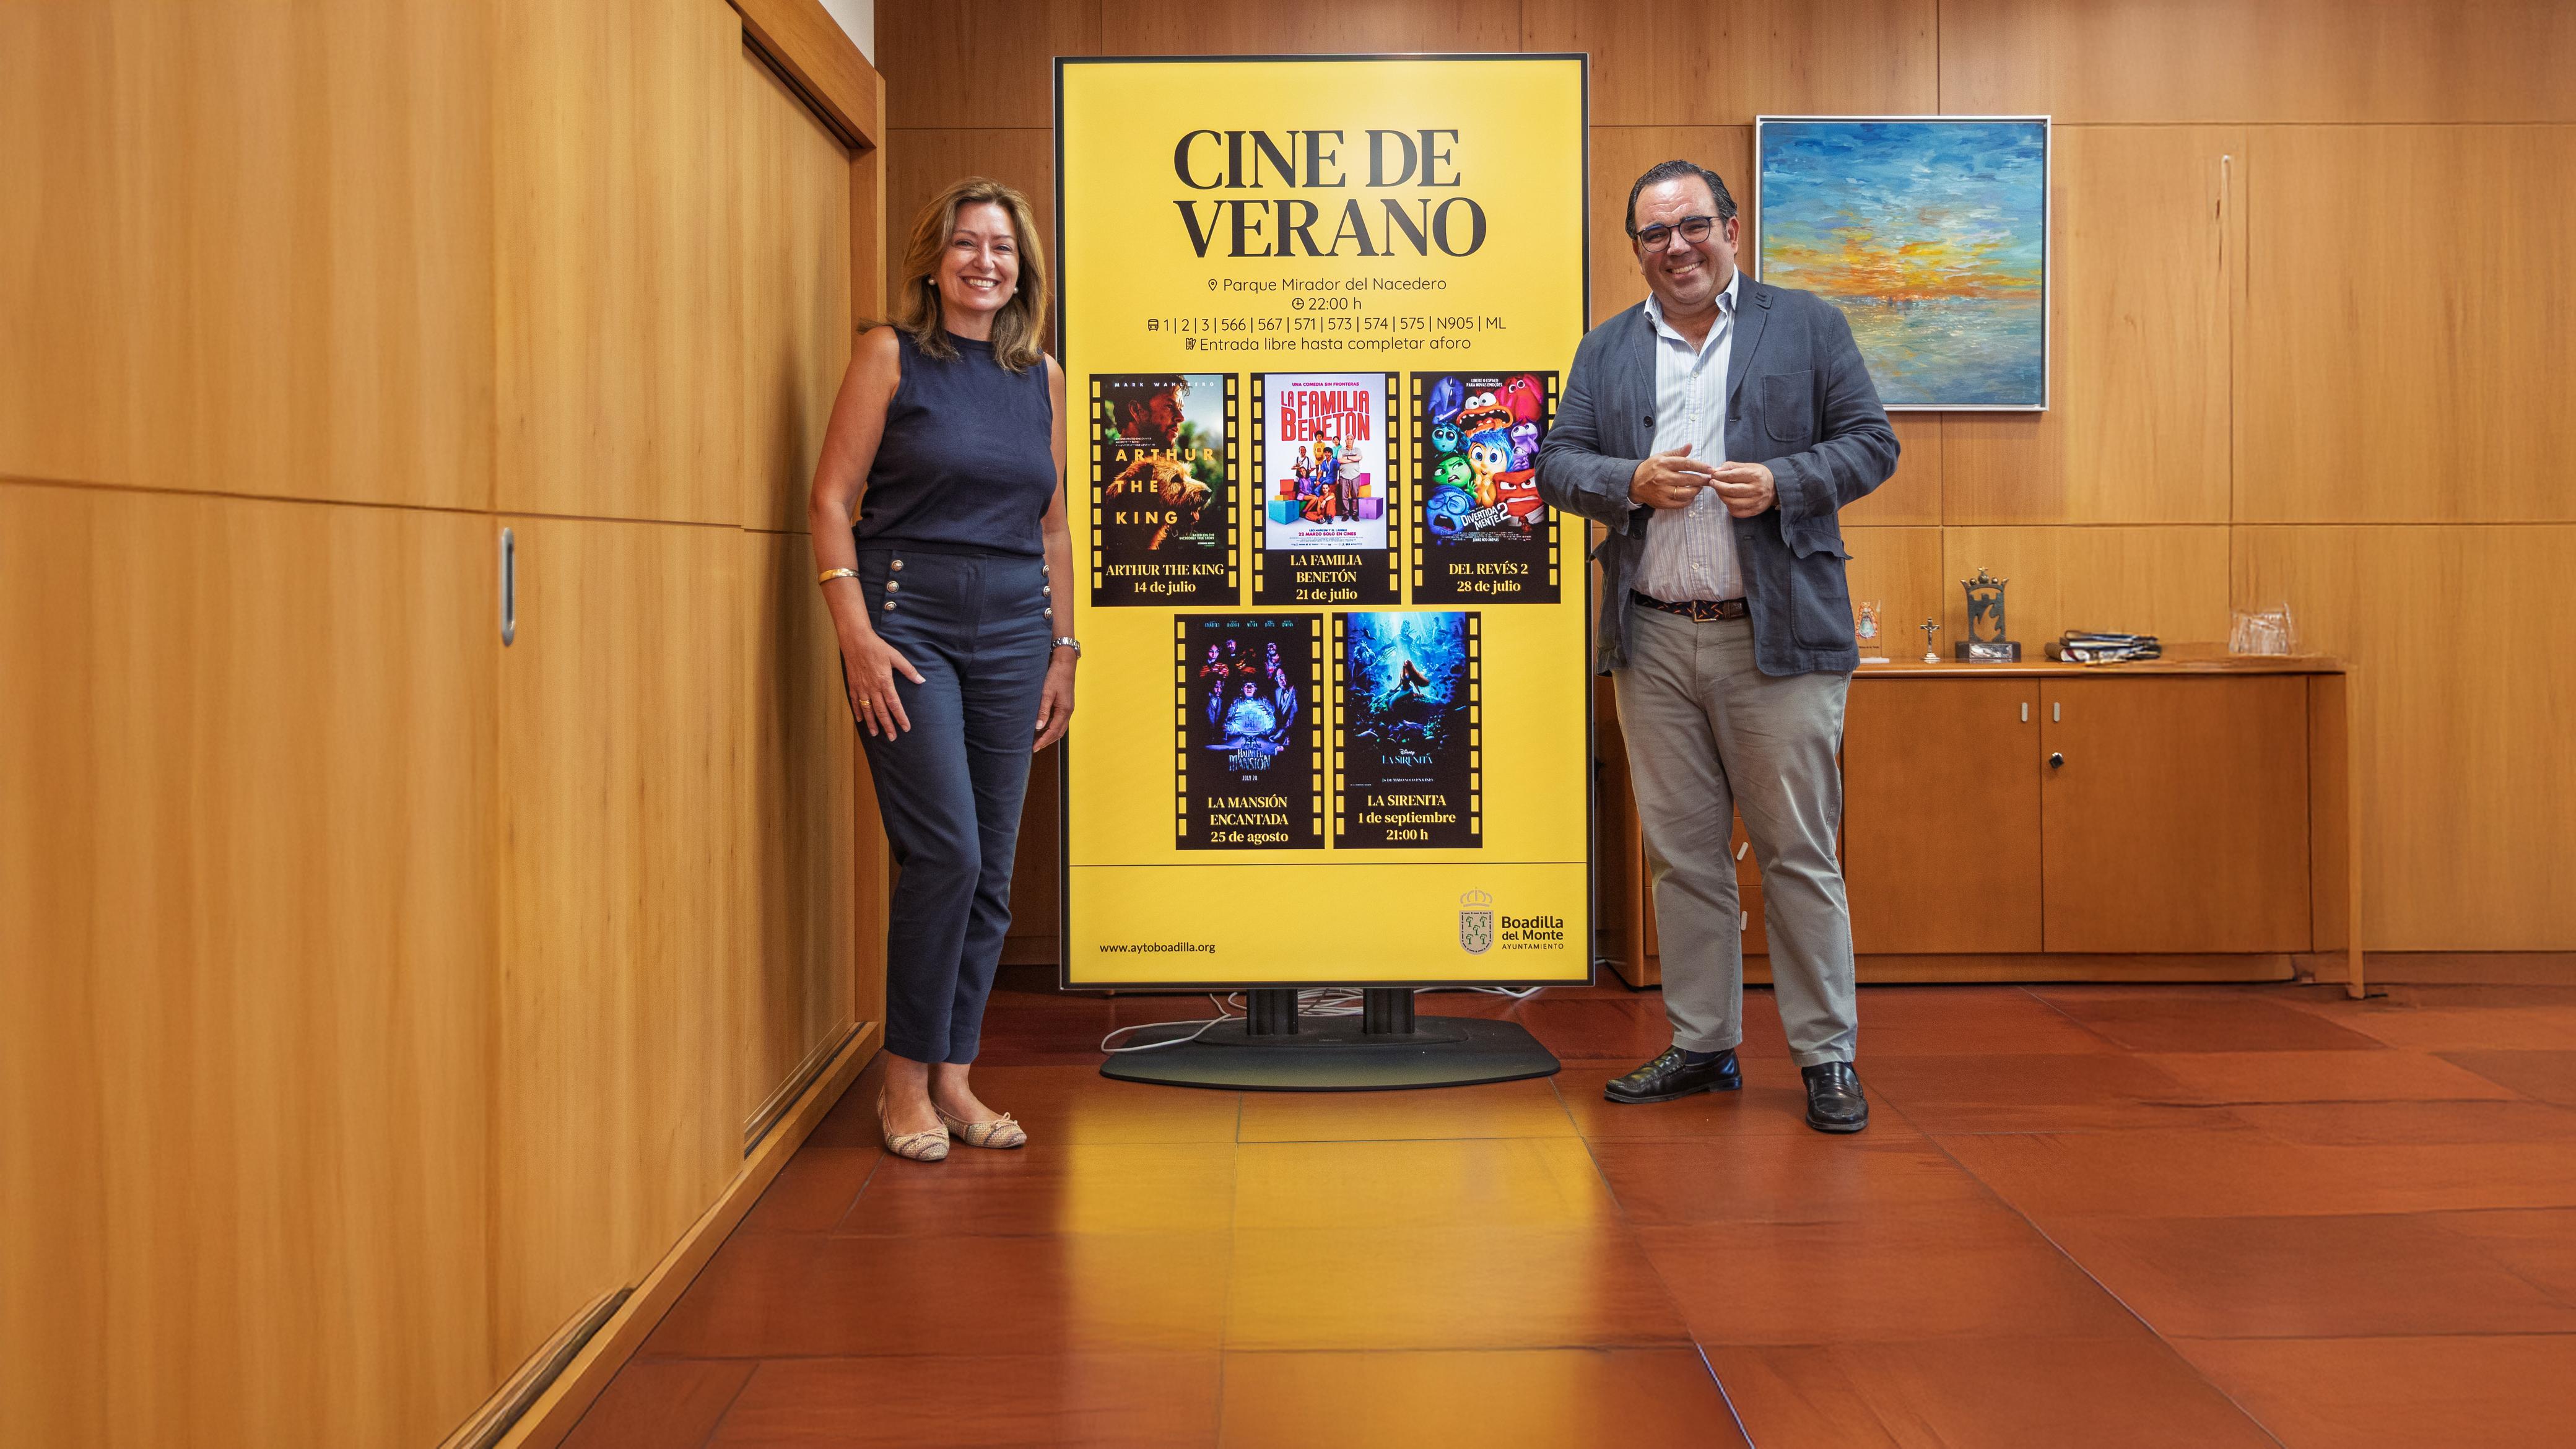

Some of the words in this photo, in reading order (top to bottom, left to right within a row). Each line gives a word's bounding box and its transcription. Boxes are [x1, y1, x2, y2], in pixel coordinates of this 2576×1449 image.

[1174, 130, 1345, 189] CINE
[1365, 129, 1460, 187] DE
[1173, 198, 1486, 258] VERANO
[1224, 279, 1276, 294] Parque
[1283, 278, 1340, 290] Mirador
[1346, 277, 1367, 290] del
[1373, 277, 1446, 290] Nacedero
[1309, 298, 1347, 310] 22:00
[1354, 297, 1361, 309] h
[1164, 320, 1168, 331] 1
[1182, 319, 1189, 331] 2
[1202, 319, 1209, 331] 3
[1222, 318, 1245, 331] 566
[1259, 318, 1282, 330] 567
[1295, 318, 1315, 330] 571
[1329, 318, 1351, 329] 573
[1365, 318, 1388, 329] 574
[1401, 318, 1424, 329] 575
[1438, 317, 1473, 329] N905
[1487, 317, 1506, 329] ML
[1201, 338, 1258, 350] Entrada
[1265, 337, 1295, 350] libre
[1302, 337, 1342, 349] hasta
[1348, 337, 1424, 352] completar
[1430, 336, 1470, 349] aforo
[1281, 391, 1294, 407] LA
[1298, 391, 1370, 418] FAMILIA
[1115, 448, 1214, 461] ARTHUR
[1116, 481, 1158, 493] THE
[1116, 511, 1178, 524] KING
[1460, 507, 1499, 526] DIVERTIDA
[1497, 502, 1511, 521] 2
[1474, 516, 1501, 531] MENTE
[1291, 555, 1307, 565] LA
[1311, 555, 1362, 565] FAMILIA
[1106, 565, 1159, 575] ARTHUR
[1163, 565, 1189, 575] THE
[1193, 564, 1224, 575] KING
[1450, 564, 1473, 574] DEL
[1477, 561, 1517, 574] REVÉS
[1521, 564, 1528, 574] 2
[1297, 569, 1356, 582] BENETÓN
[1135, 582, 1147, 592] 14
[1150, 581, 1165, 592] de
[1167, 581, 1196, 595] julio
[1458, 581, 1471, 591] 28
[1475, 581, 1490, 591] de
[1491, 580, 1520, 594] julio
[1297, 590, 1308, 599] 21
[1312, 589, 1326, 599] de
[1328, 588, 1357, 603] julio
[1238, 749, 1264, 761] HAUNTED
[1382, 755, 1394, 765] LA
[1229, 755, 1271, 772] MANSION
[1209, 798, 1225, 807] LA
[1229, 794, 1287, 807] MANSIÓN
[1368, 796, 1384, 806] LA
[1388, 795, 1446, 806] SIRENITA
[1211, 814, 1288, 825] ENCANTADA
[1359, 813, 1363, 823] 1
[1367, 812, 1382, 823] de
[1385, 812, 1456, 826] septiembre
[1211, 832, 1225, 842] 25
[1229, 831, 1244, 842] de
[1248, 832, 1288, 845] agosto
[1386, 830, 1417, 840] 21:00
[1421, 829, 1428, 840] h
[1502, 916, 1563, 928] Boadilla
[1502, 931, 1519, 940] del
[1523, 930, 1563, 940] Monte
[1100, 942, 1215, 954] www.aytoboadilla.org
